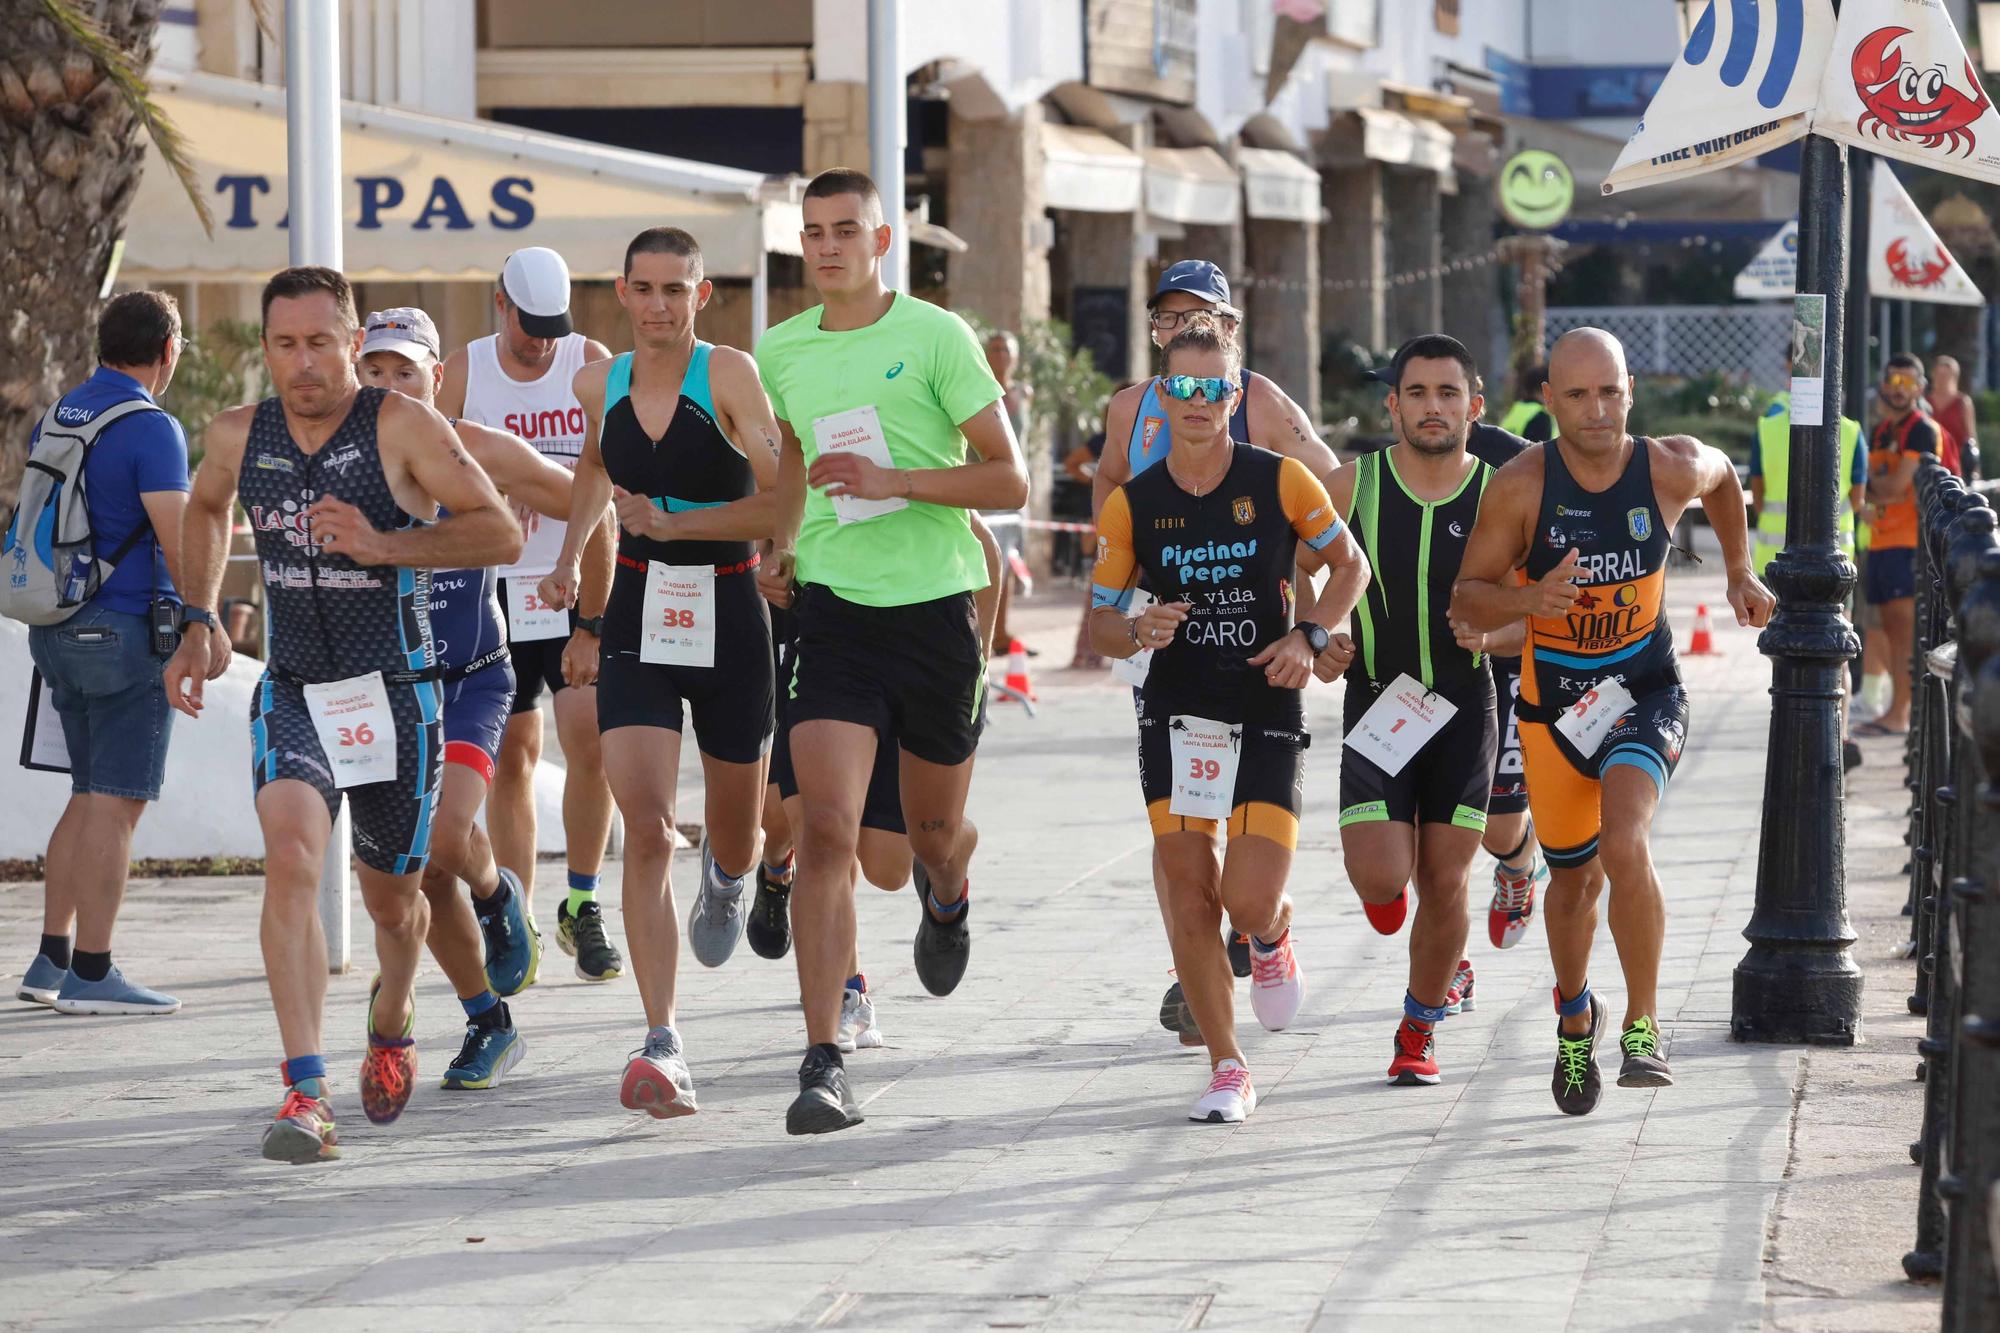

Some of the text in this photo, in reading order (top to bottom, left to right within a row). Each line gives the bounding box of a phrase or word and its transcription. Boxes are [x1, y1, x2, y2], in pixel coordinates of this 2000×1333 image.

[215, 176, 535, 230] TPAS
[829, 441, 846, 450] SANTA
[1155, 518, 1185, 529] GOBIK
[1161, 539, 1257, 567] Piscinas
[1179, 564, 1243, 585] Pepe
[1567, 548, 1647, 584] ERRAL
[657, 589, 675, 597] SANTA
[1178, 588, 1256, 605] K vida
[663, 608, 695, 628] 38
[1191, 605, 1248, 615] Sant Antoni
[1186, 619, 1256, 646] CARO
[1584, 638, 1623, 650] IBIZA
[1559, 673, 1627, 691] K via
[336, 722, 375, 746] 36
[1390, 718, 1407, 734] 1
[1189, 758, 1220, 781] 39
